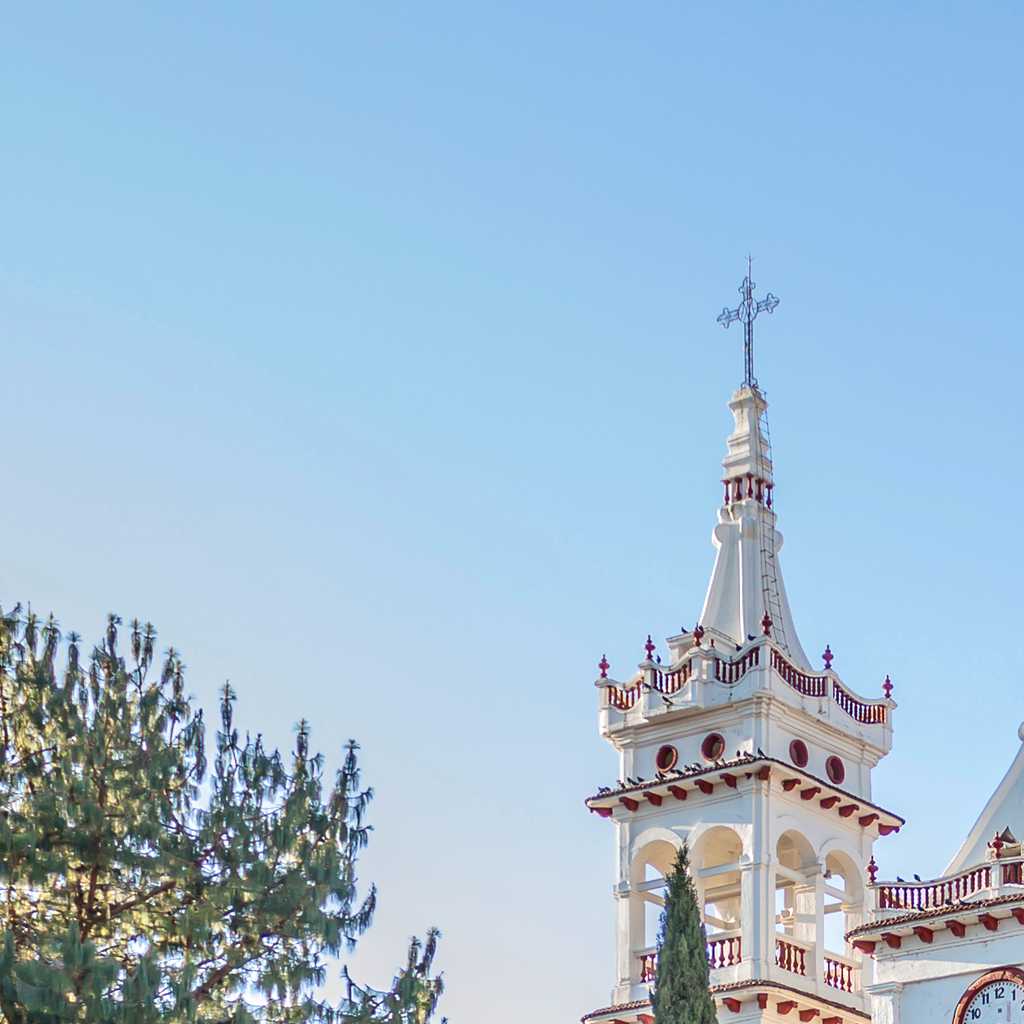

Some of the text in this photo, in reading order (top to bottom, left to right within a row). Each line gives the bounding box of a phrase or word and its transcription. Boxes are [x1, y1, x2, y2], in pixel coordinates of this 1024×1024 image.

[982, 993, 990, 1005] 11
[994, 987, 1005, 999] 12
[1011, 989, 1015, 1000] 1
[971, 1007, 981, 1020] 10
